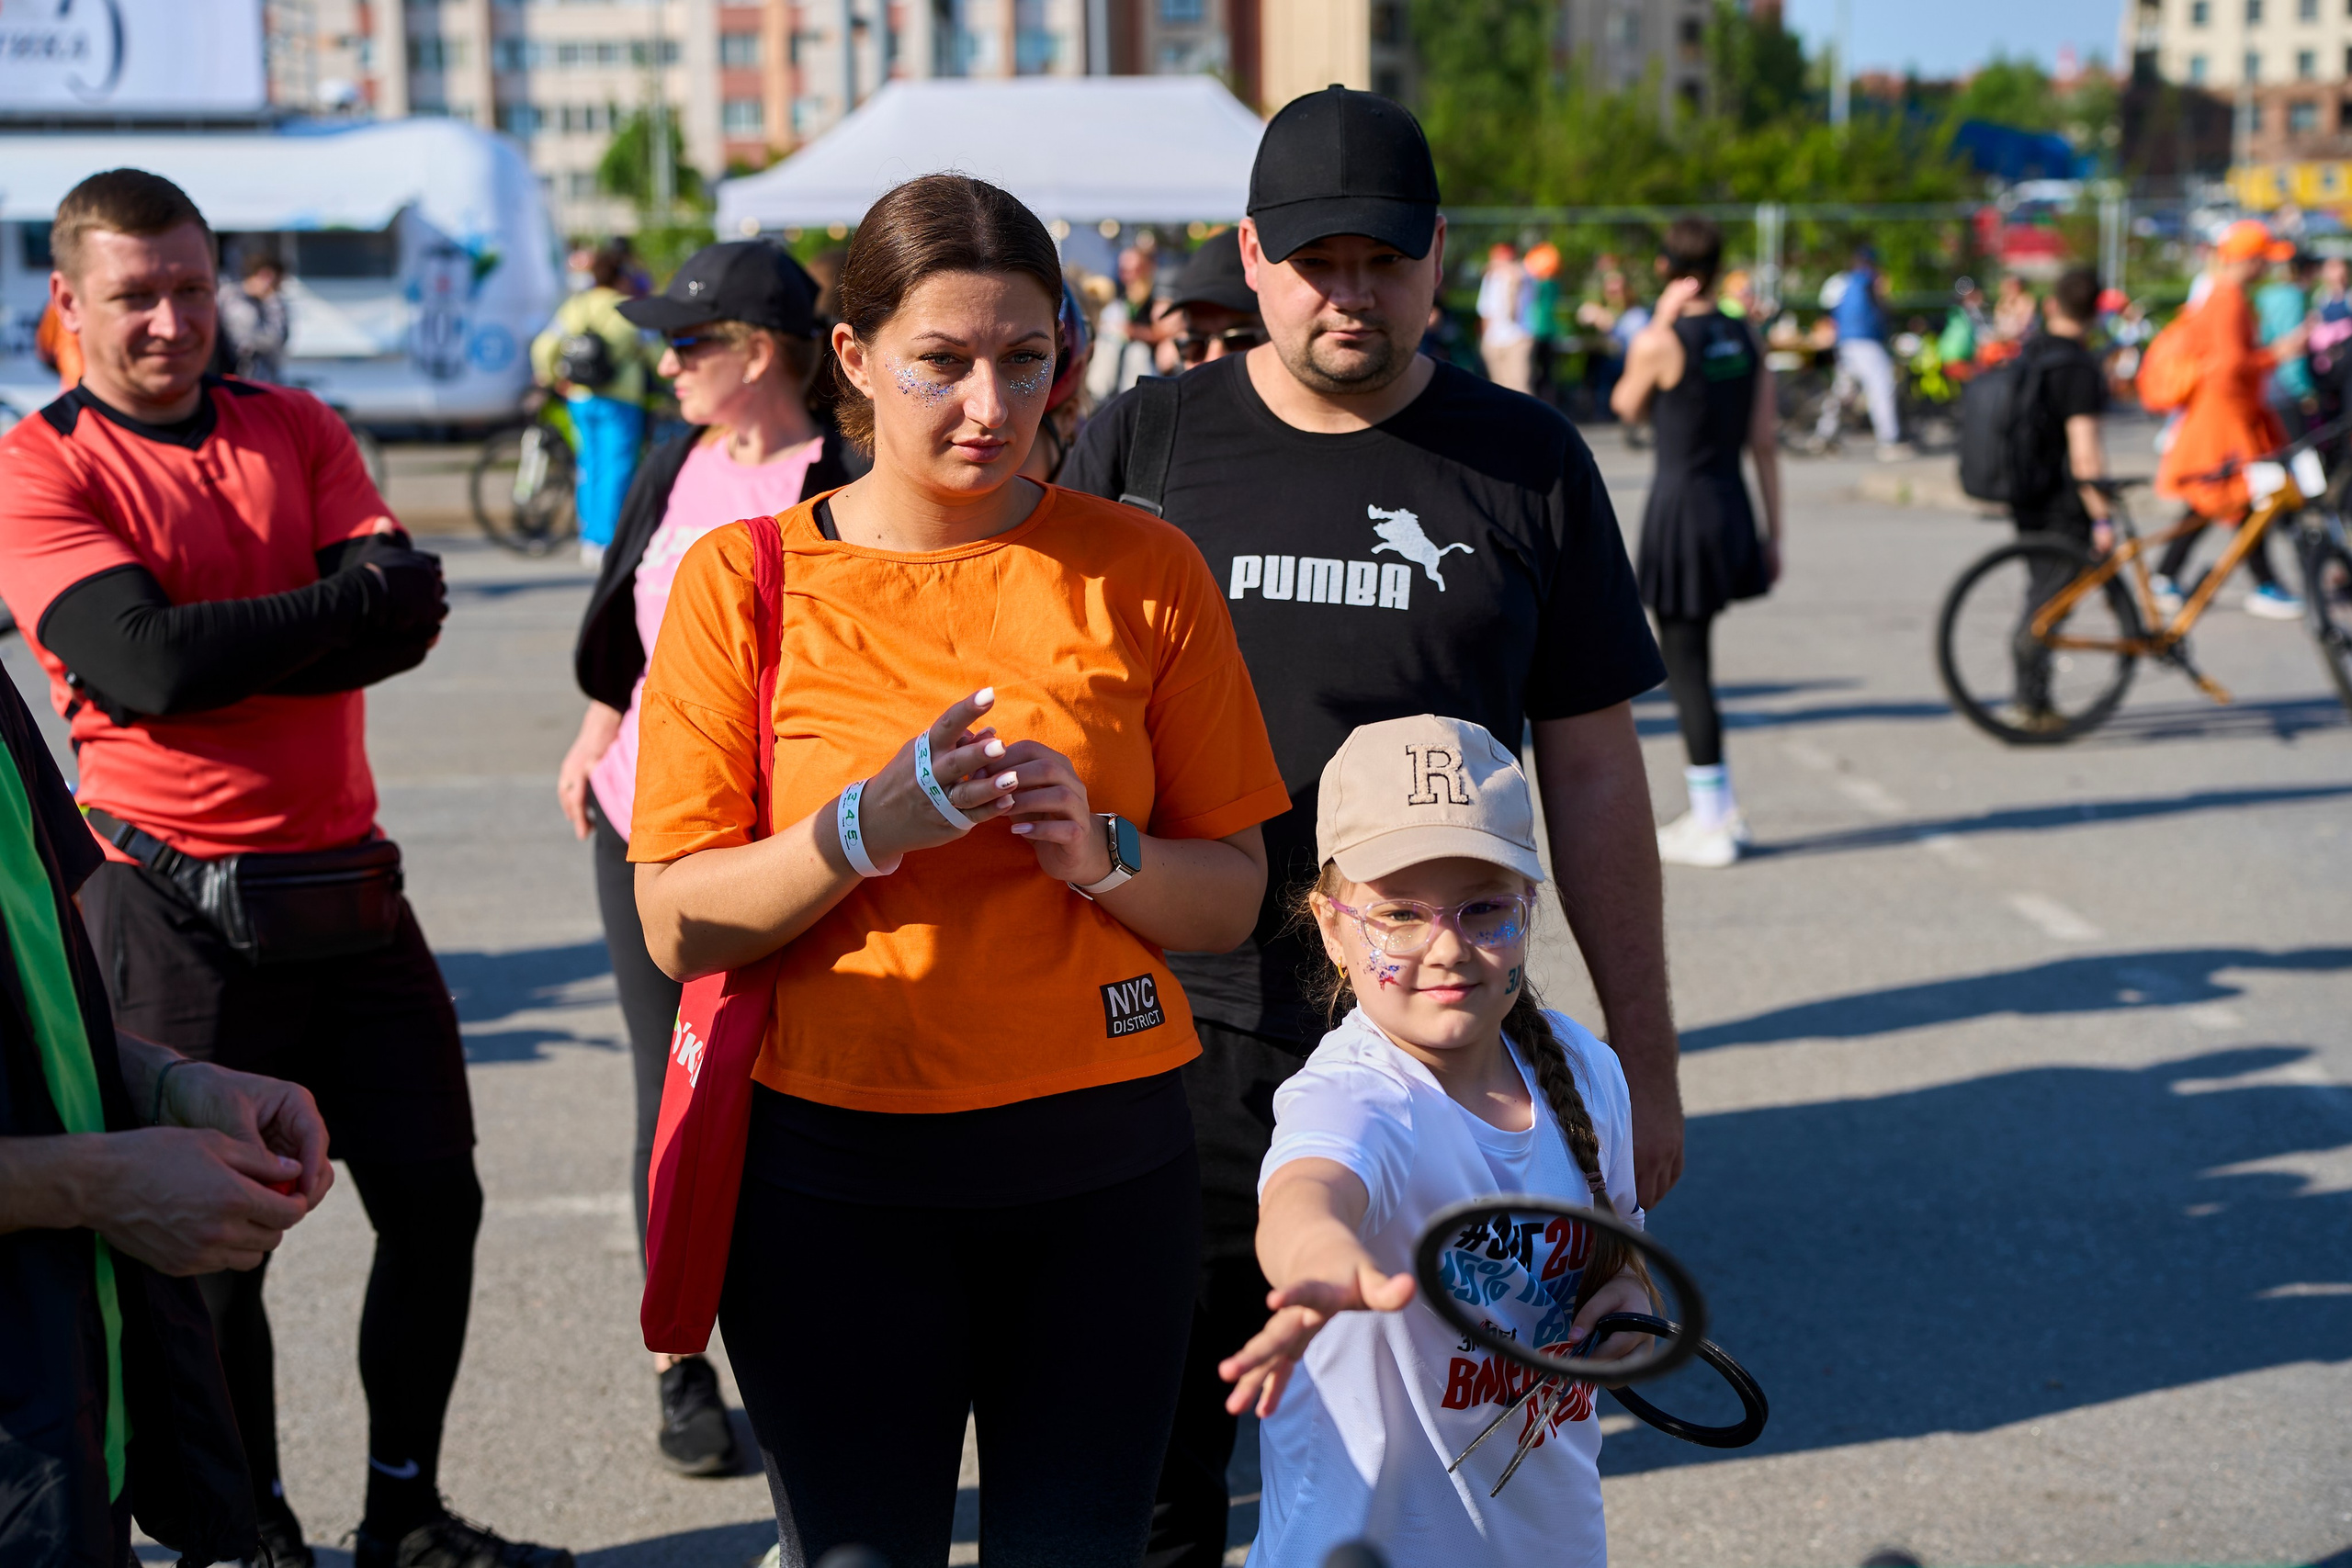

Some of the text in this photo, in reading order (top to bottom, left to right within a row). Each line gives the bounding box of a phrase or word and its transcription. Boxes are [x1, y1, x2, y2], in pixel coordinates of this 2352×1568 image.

[1229, 555, 1412, 611] PUMBA
[1406, 743, 1470, 806] R
[1107, 977, 1154, 1018] NYC
[1114, 1010, 1160, 1034] DISTRICT
[1540, 1217, 1594, 1282] 20
